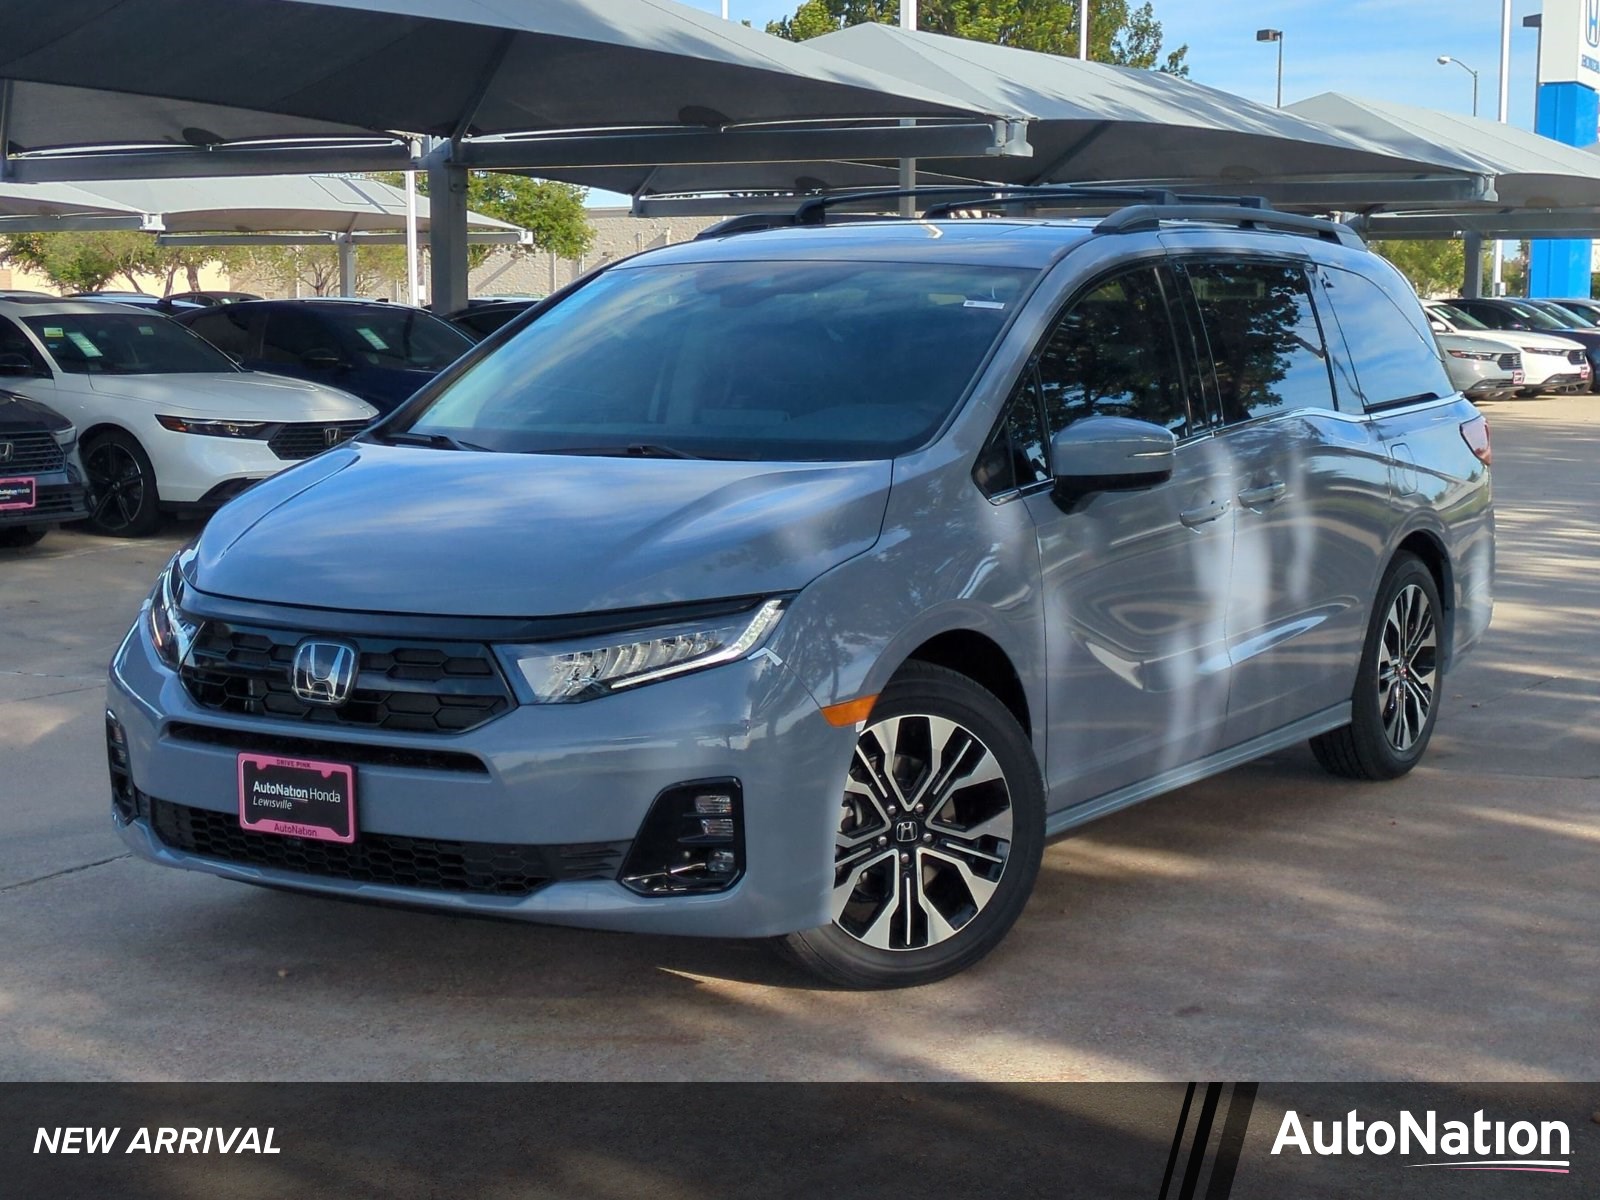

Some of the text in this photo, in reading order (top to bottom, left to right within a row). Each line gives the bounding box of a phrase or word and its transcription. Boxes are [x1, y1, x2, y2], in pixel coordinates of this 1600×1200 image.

[276, 759, 311, 769] DRIVE PINK
[253, 781, 341, 803] AutoNation Honda
[253, 796, 292, 810] Lewisville
[273, 823, 317, 837] AutoNation
